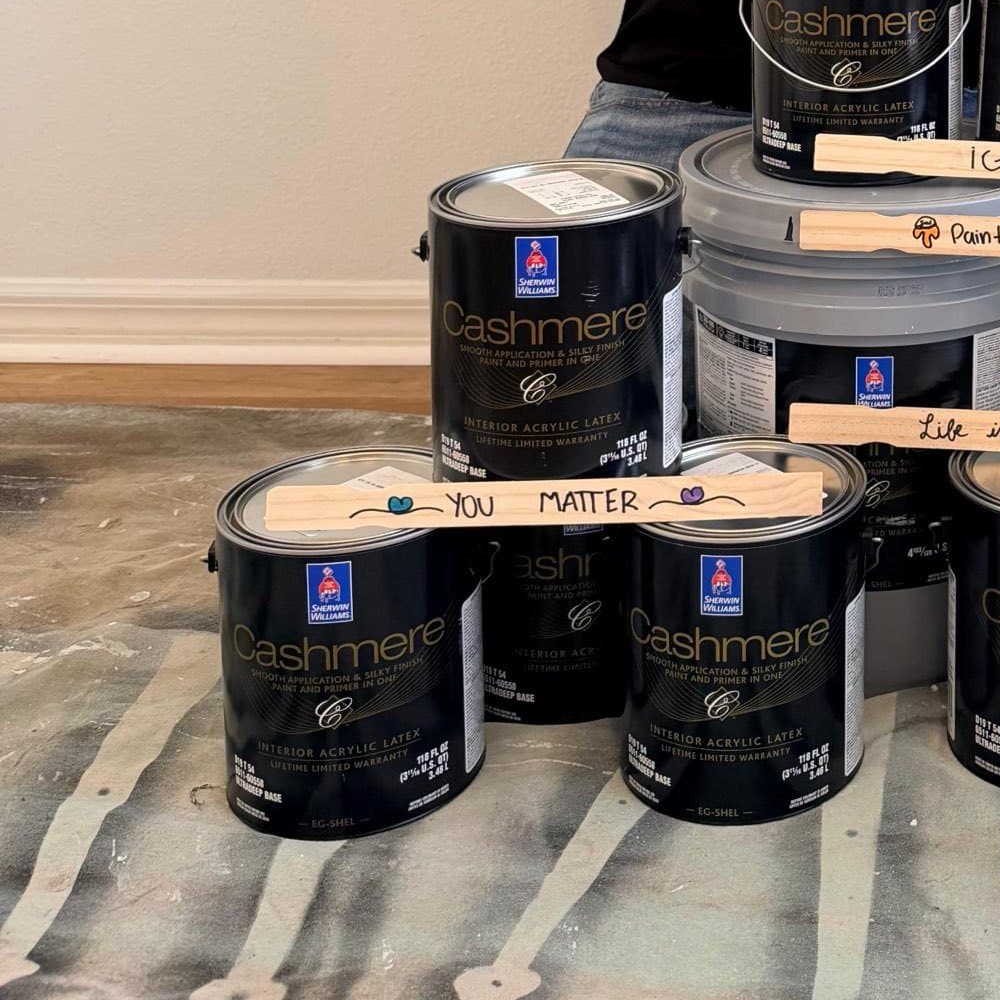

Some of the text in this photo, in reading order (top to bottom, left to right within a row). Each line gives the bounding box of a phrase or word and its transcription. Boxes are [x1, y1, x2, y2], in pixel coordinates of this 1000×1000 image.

[766, 0, 936, 36] Cashmere
[784, 99, 914, 112] INTERIOR ACRYLIC LATEX
[517, 286, 556, 295] WILLIAMS
[519, 278, 555, 286] SHERWIN
[443, 300, 648, 345] Cashmere
[464, 412, 621, 433] INTERIOR ACRYLIC LATEX
[919, 413, 968, 440] Life
[476, 431, 609, 447] LIFETIME LIMITED WARRANTY
[446, 488, 638, 518] YOU MATTER
[312, 603, 350, 613] SHERWIN
[703, 603, 740, 612] WILLIAMS
[704, 595, 740, 604] SHERWIN
[311, 611, 350, 621] WILLIAMS
[631, 608, 830, 662] Cashmere
[234, 617, 445, 672] Cashmere
[258, 728, 421, 758] INTERIOR ACRYLIC LATEX
[650, 724, 803, 748] INTERIOR ACRYLIC LATEX
[354, 748, 408, 769] WARRANTY
[661, 744, 791, 762] LIFETIME LIMITED WARRANTY
[264, 788, 282, 803] BASE
[698, 807, 738, 817] EG-SHEL
[312, 817, 355, 828] EG-SHEL
